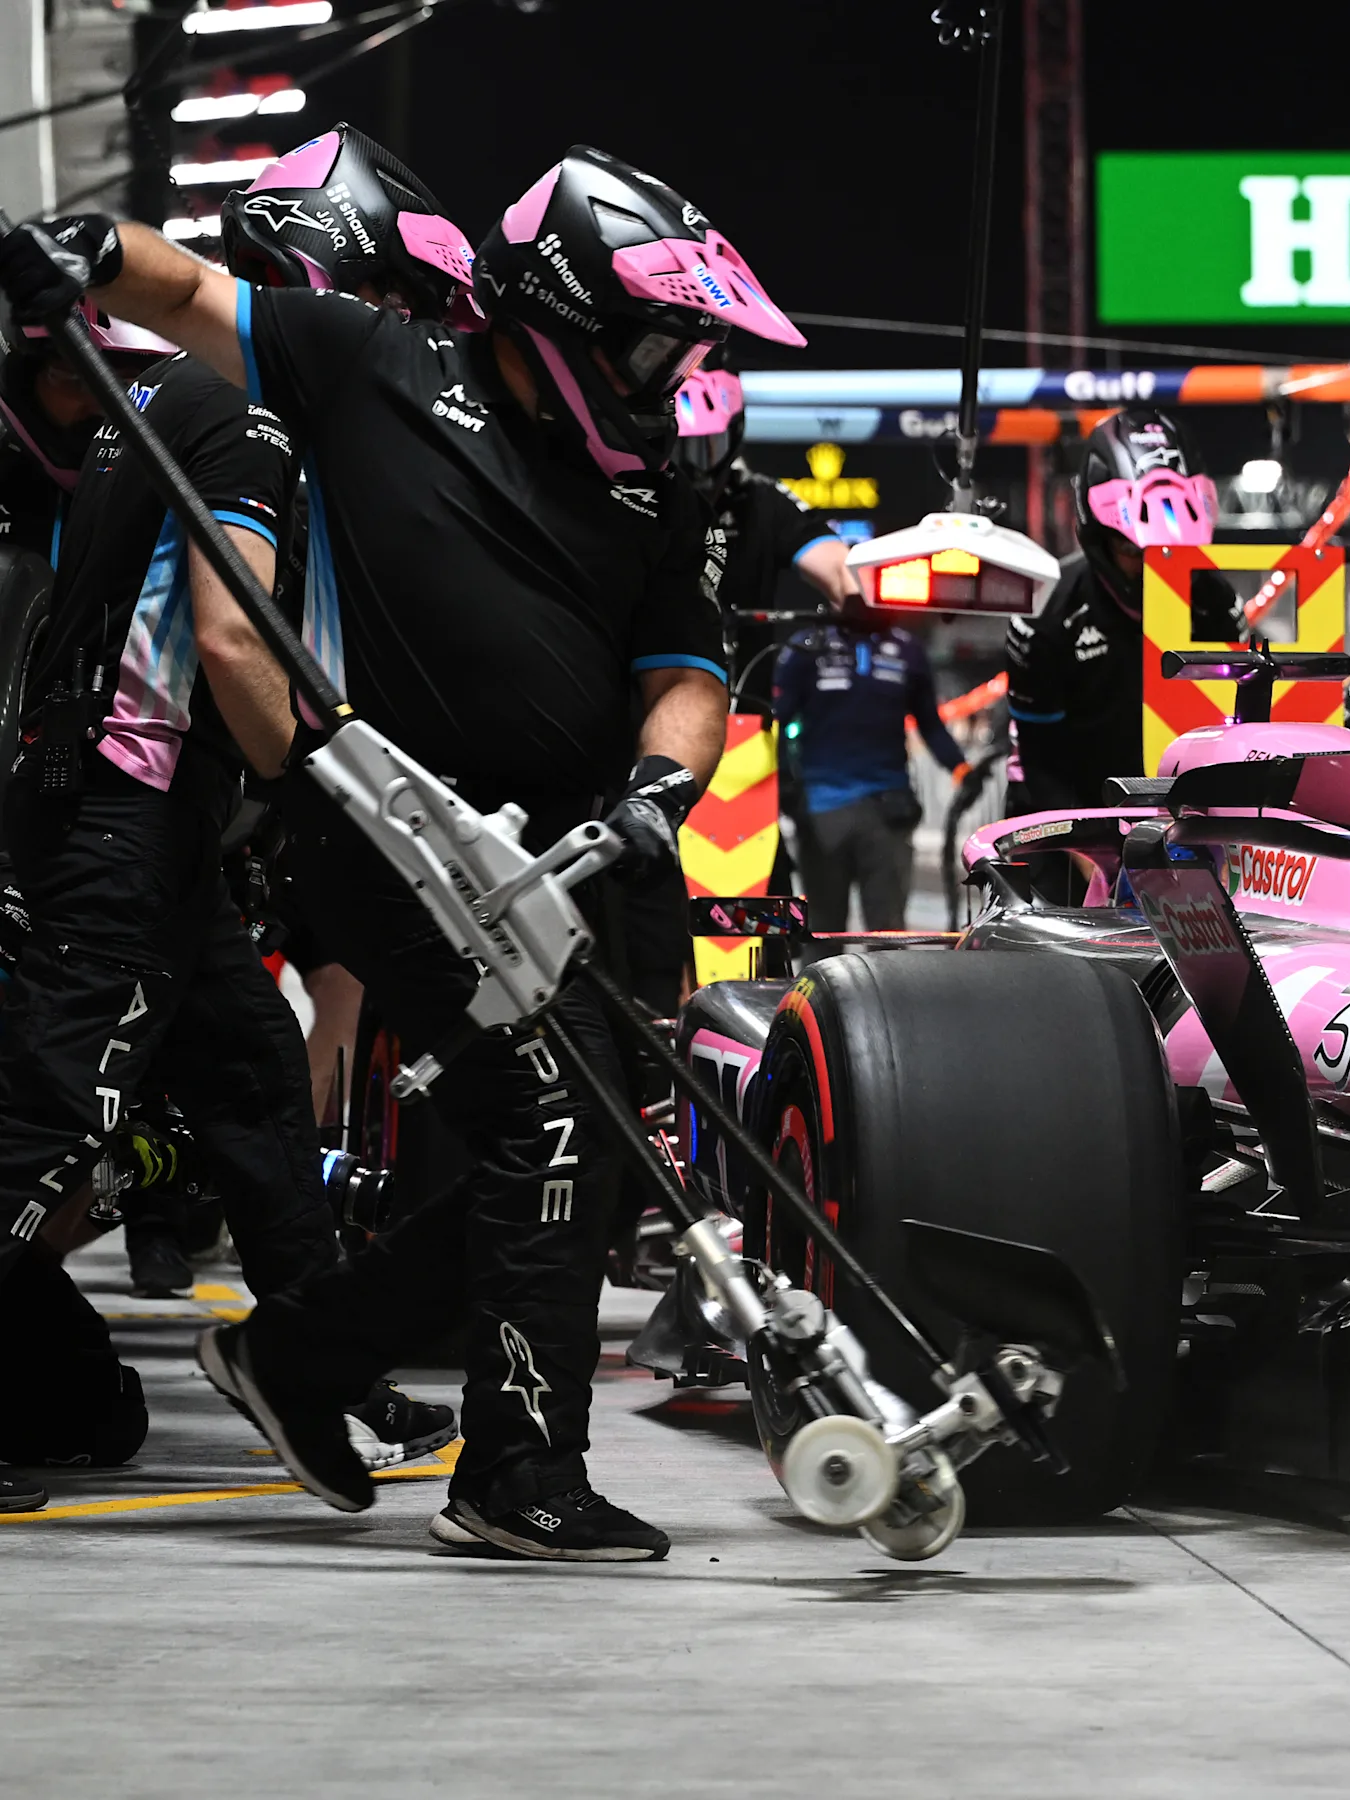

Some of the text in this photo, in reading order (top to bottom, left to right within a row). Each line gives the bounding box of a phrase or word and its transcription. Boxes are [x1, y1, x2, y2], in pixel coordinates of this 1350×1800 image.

[338, 200, 376, 256] shamir
[536, 287, 605, 333] shamir
[700, 274, 734, 309] BWT
[1064, 369, 1156, 402] Gulf
[445, 405, 486, 433] BWT
[1018, 820, 1074, 844] Castrol EDGE
[1240, 844, 1318, 903] Castrol
[1163, 898, 1237, 954] Castrol
[510, 1032, 579, 1223] PINE
[524, 1505, 563, 1530] arco
